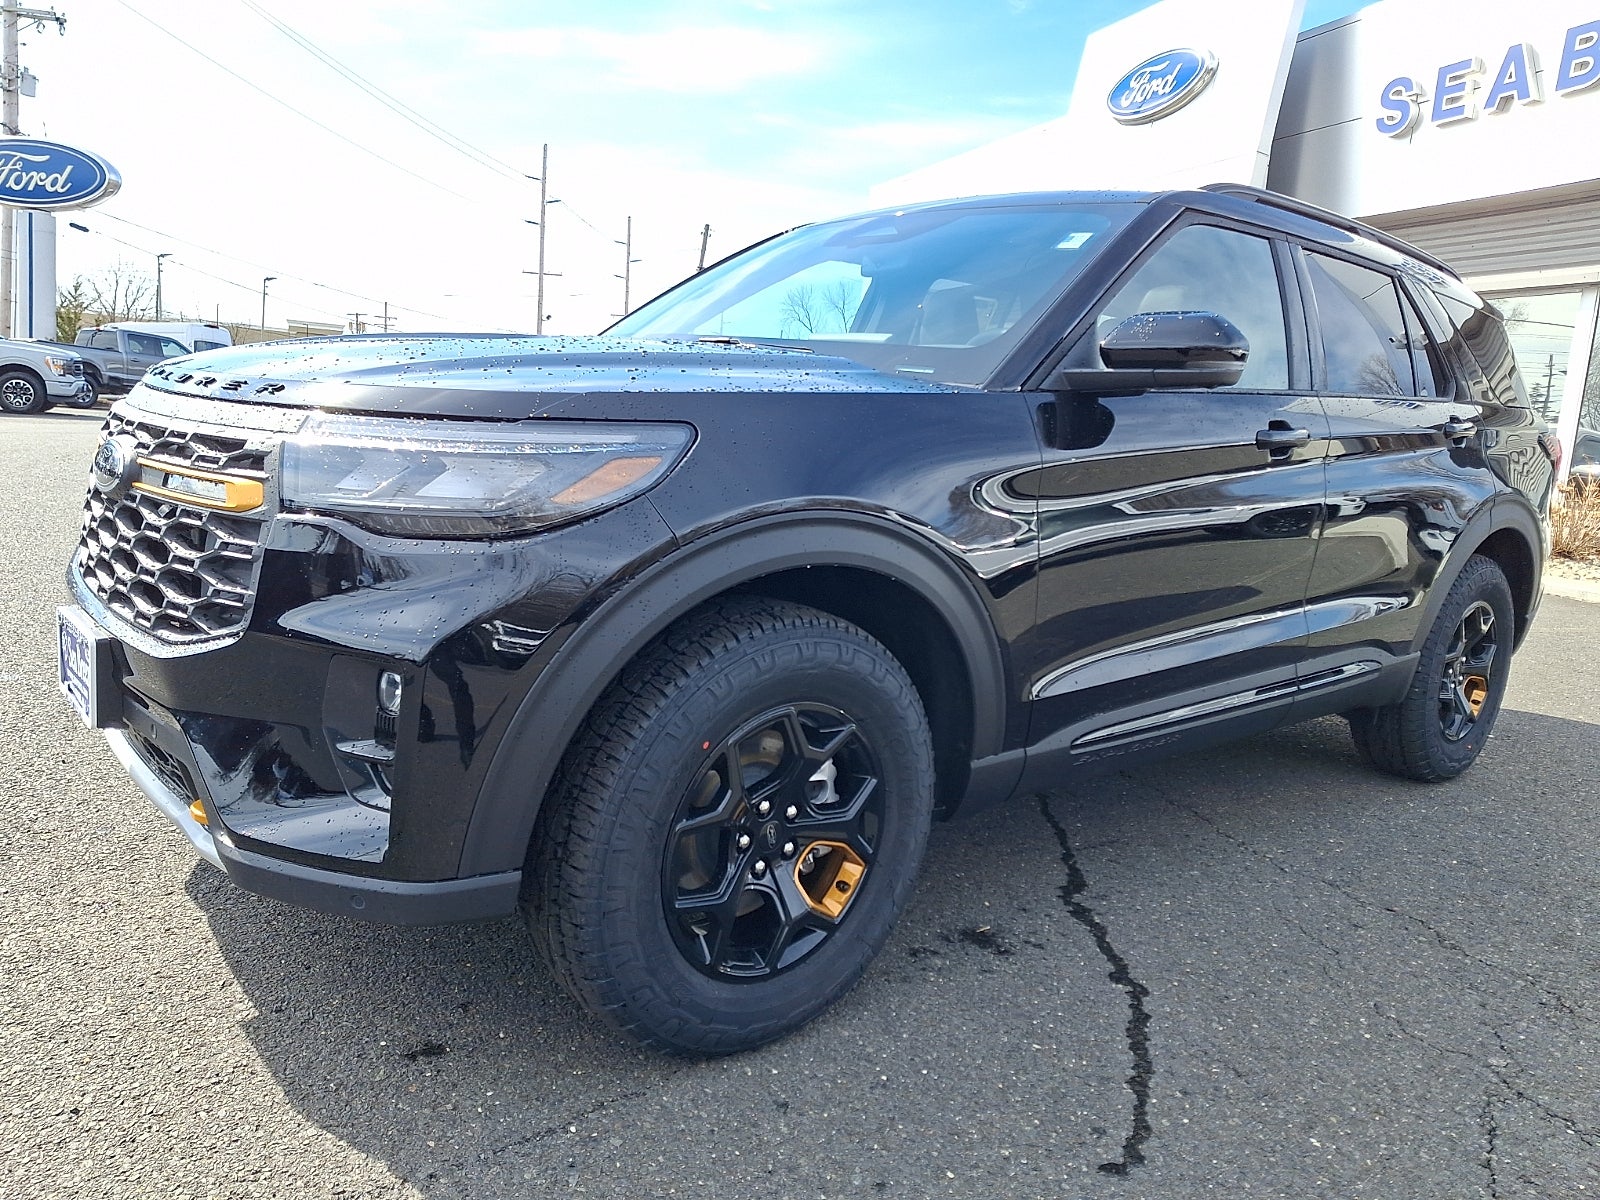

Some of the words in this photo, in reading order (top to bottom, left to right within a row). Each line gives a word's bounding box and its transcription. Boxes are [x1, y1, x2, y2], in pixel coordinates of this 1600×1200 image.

[1120, 60, 1184, 108] Ford
[1375, 19, 1600, 138] SEAB
[0, 150, 75, 194] Ford
